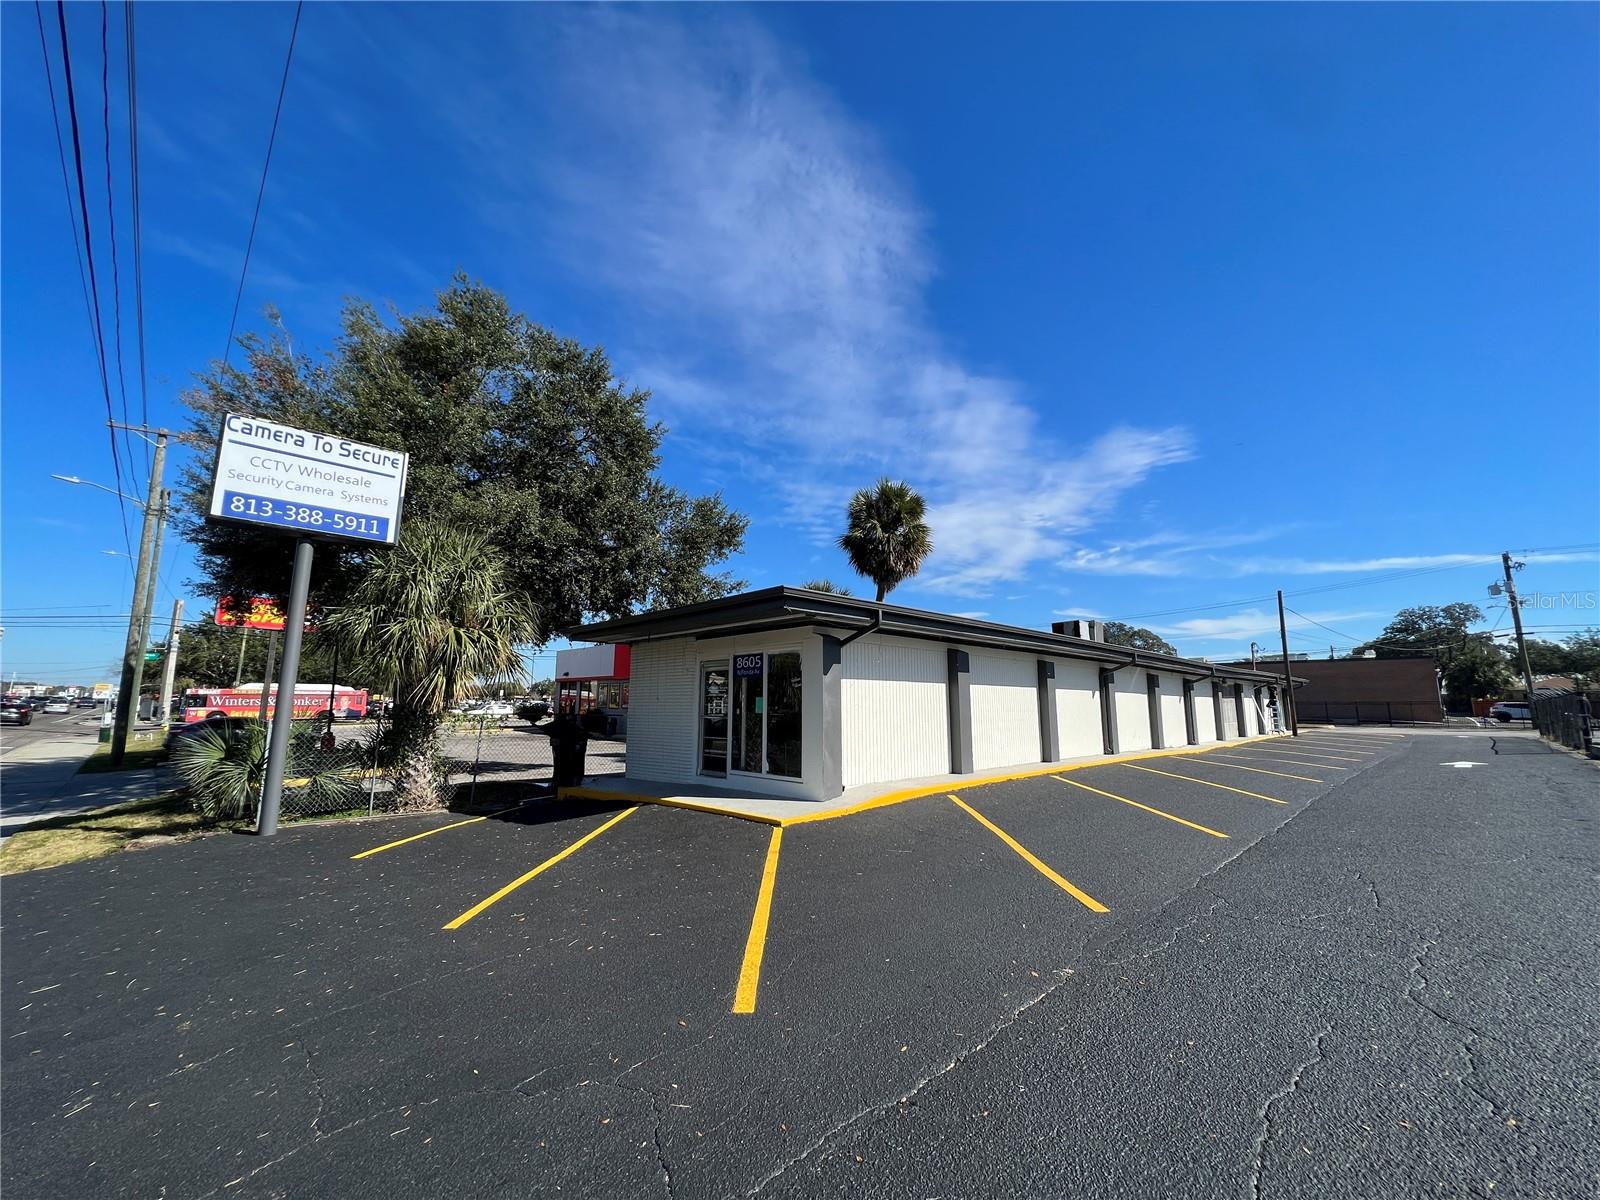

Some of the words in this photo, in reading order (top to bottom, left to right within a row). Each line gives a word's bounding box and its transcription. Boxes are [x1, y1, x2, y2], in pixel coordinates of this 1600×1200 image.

[226, 415, 305, 448] Camera
[312, 434, 334, 454] To
[338, 442, 400, 469] Secure
[227, 468, 284, 489] Security
[285, 480, 334, 497] Camera
[340, 490, 389, 507] Systems
[250, 456, 294, 473] CCTV
[298, 464, 372, 489] Wholesale
[230, 496, 380, 535] 813-388-5911
[736, 656, 761, 668] 8605
[210, 695, 262, 706] Winters
[292, 696, 324, 706] onker
